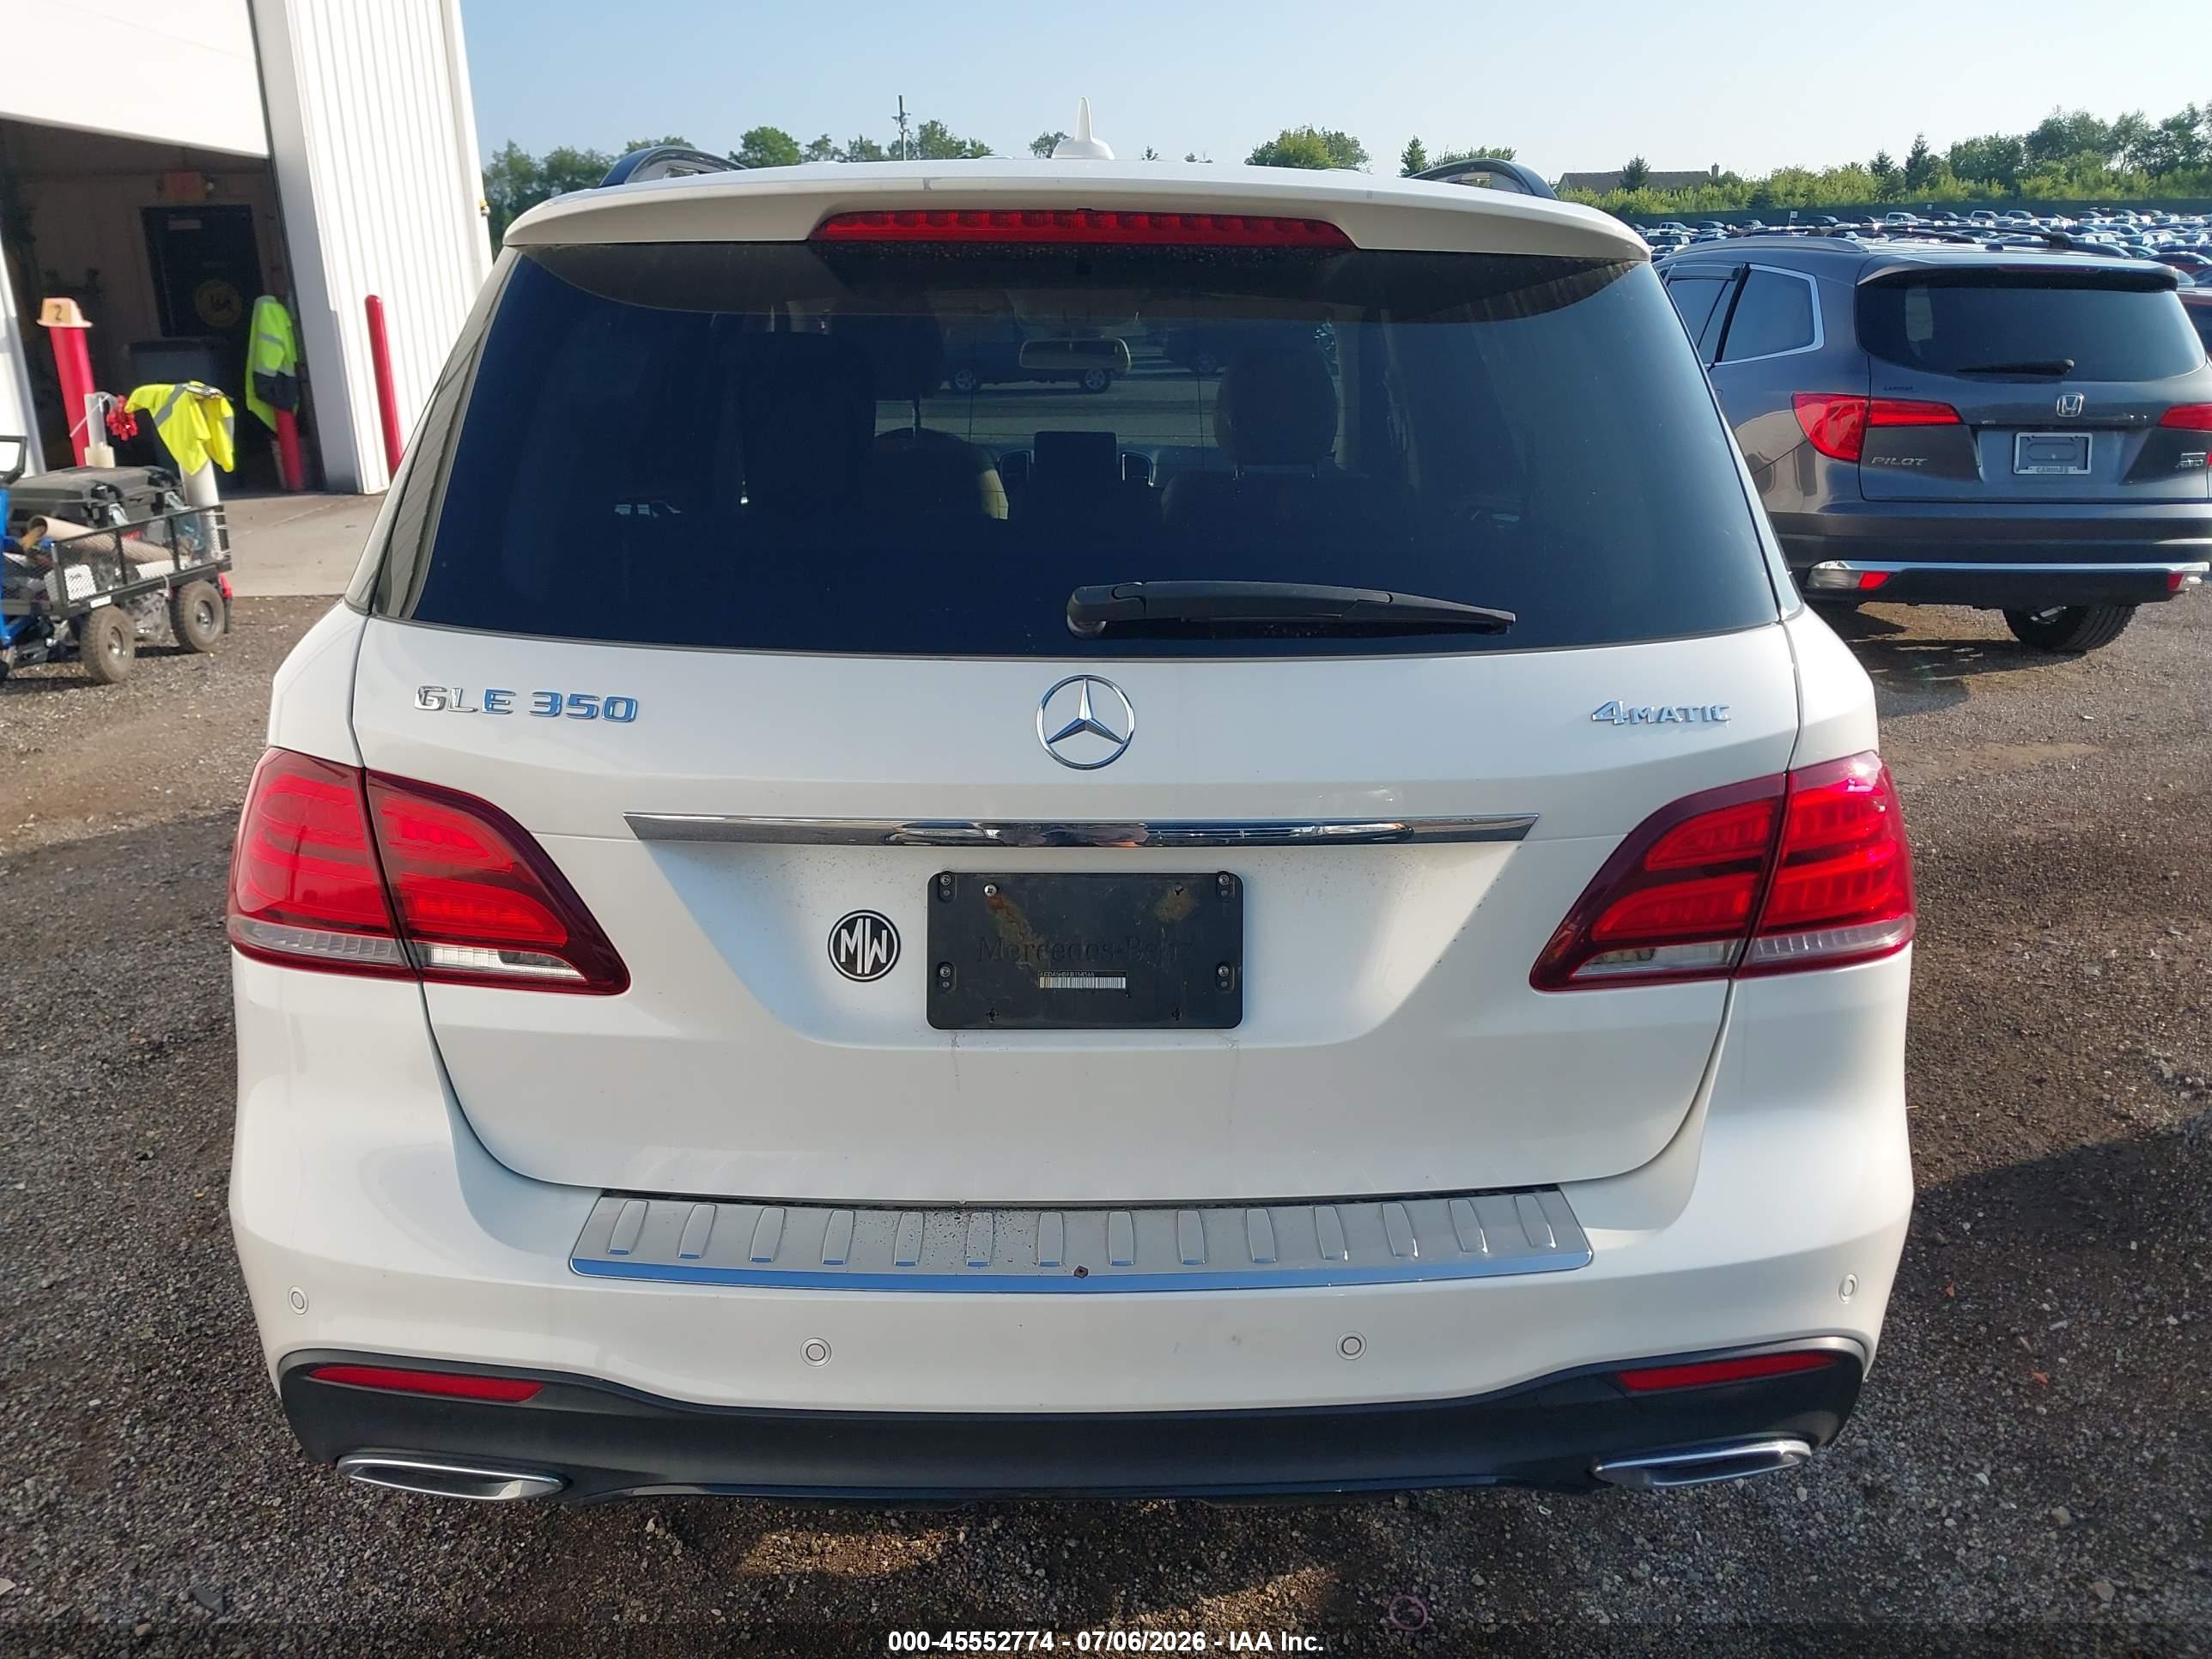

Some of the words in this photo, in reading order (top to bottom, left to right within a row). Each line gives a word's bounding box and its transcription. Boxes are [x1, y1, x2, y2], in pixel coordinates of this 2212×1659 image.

[55, 304, 62, 322] 2
[1871, 456, 1927, 466] PILOT
[414, 685, 515, 714] GLE
[528, 690, 638, 723] 350
[1591, 700, 1732, 725] 4MATIC
